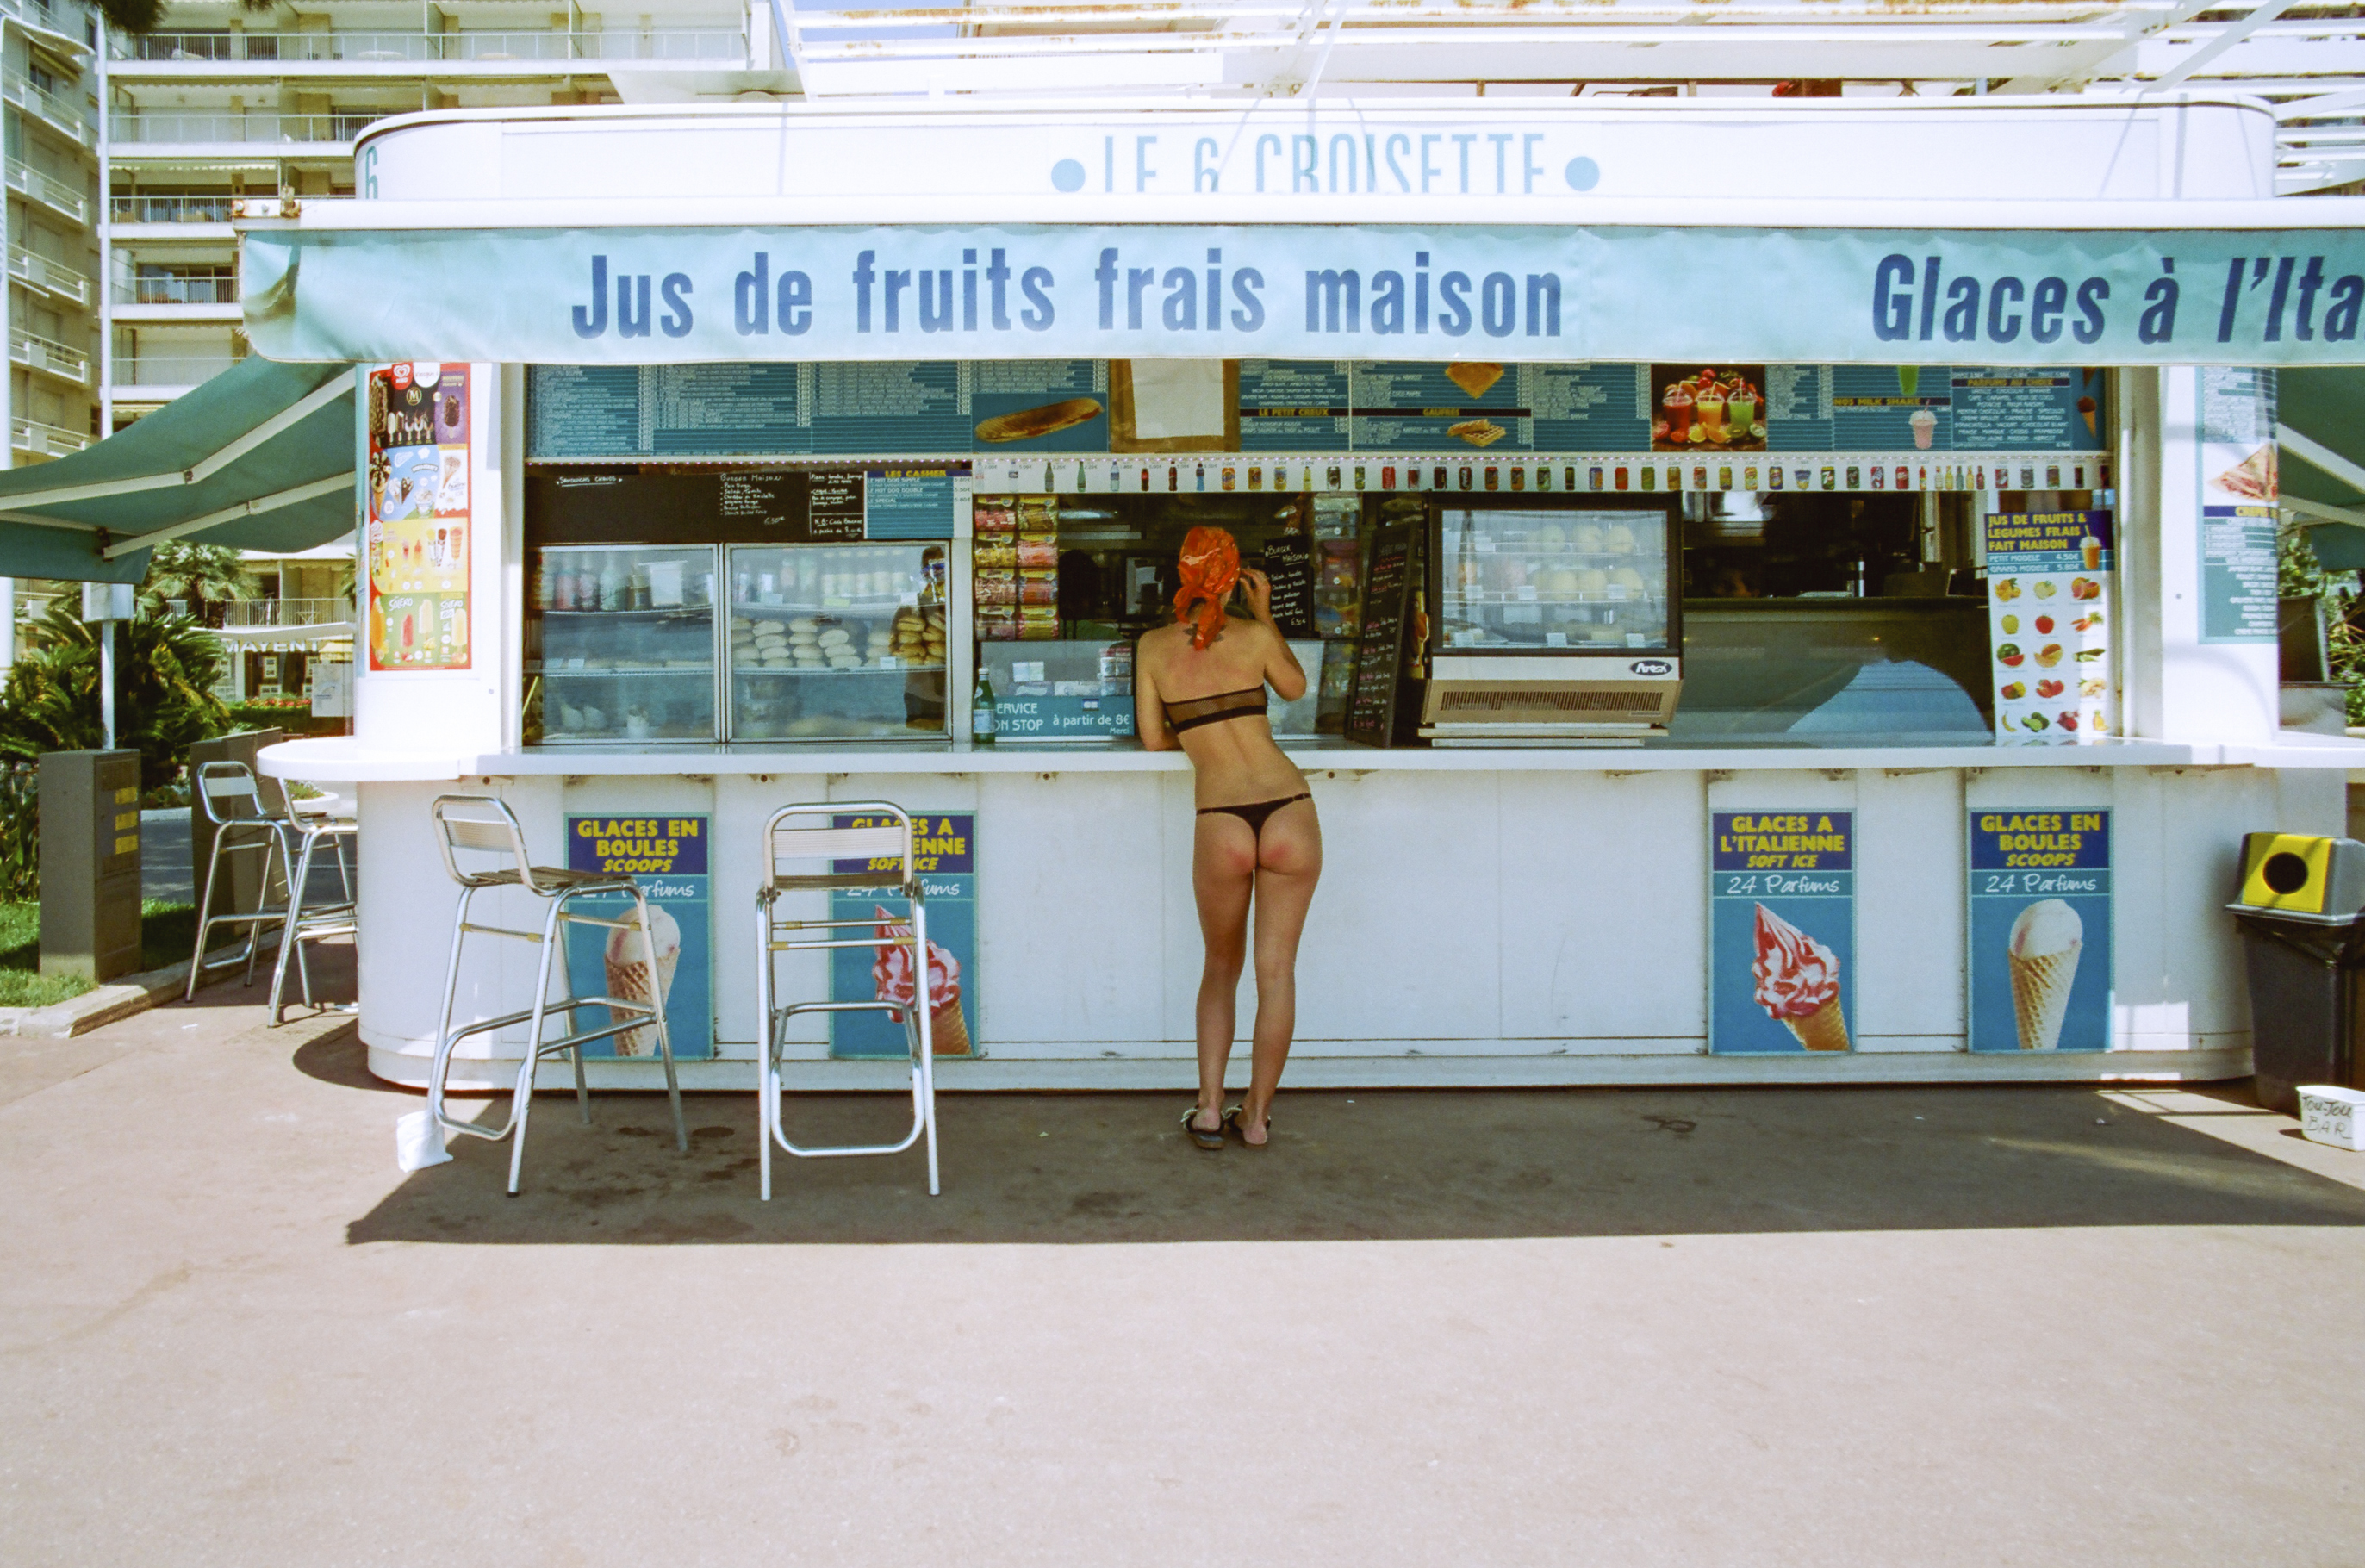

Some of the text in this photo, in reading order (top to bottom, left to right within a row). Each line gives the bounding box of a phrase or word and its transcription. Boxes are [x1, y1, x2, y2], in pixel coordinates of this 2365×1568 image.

[571, 246, 1563, 339] Jus de fruits frais maison
[1871, 252, 2112, 345] Glaces
[2138, 256, 2180, 344] à
[1833, 397, 1920, 406] NOS MILK SHAKE
[1259, 408, 1329, 417] LE PETIT CREUX
[906, 470, 947, 478] CASHER
[1988, 513, 2087, 526] JUS DE FRUITS &
[1988, 526, 2081, 538] LEGUMES FRAIS
[1988, 538, 2069, 551] FAIT MAISON
[1011, 719, 1044, 731] STOP
[1053, 713, 1130, 727] à partir de 8€
[1109, 726, 1130, 735] Merci
[576, 819, 699, 838] GLACES EN
[937, 818, 955, 836] A
[1731, 815, 1833, 833] GLACES A
[1980, 813, 2101, 832] GLACES EN
[595, 838, 679, 857] BOULES
[1720, 835, 1845, 853] L'ITALIENNE
[1998, 833, 2082, 851] BOULES
[602, 858, 673, 873] SCOOPS
[1746, 854, 1819, 868] SOFT ICE
[2005, 853, 2076, 868] SCOOPS
[1727, 874, 1840, 894] 24 Parfums
[1985, 873, 2098, 893] 24 Parfums
[2304, 1115, 2353, 1140] BAR
